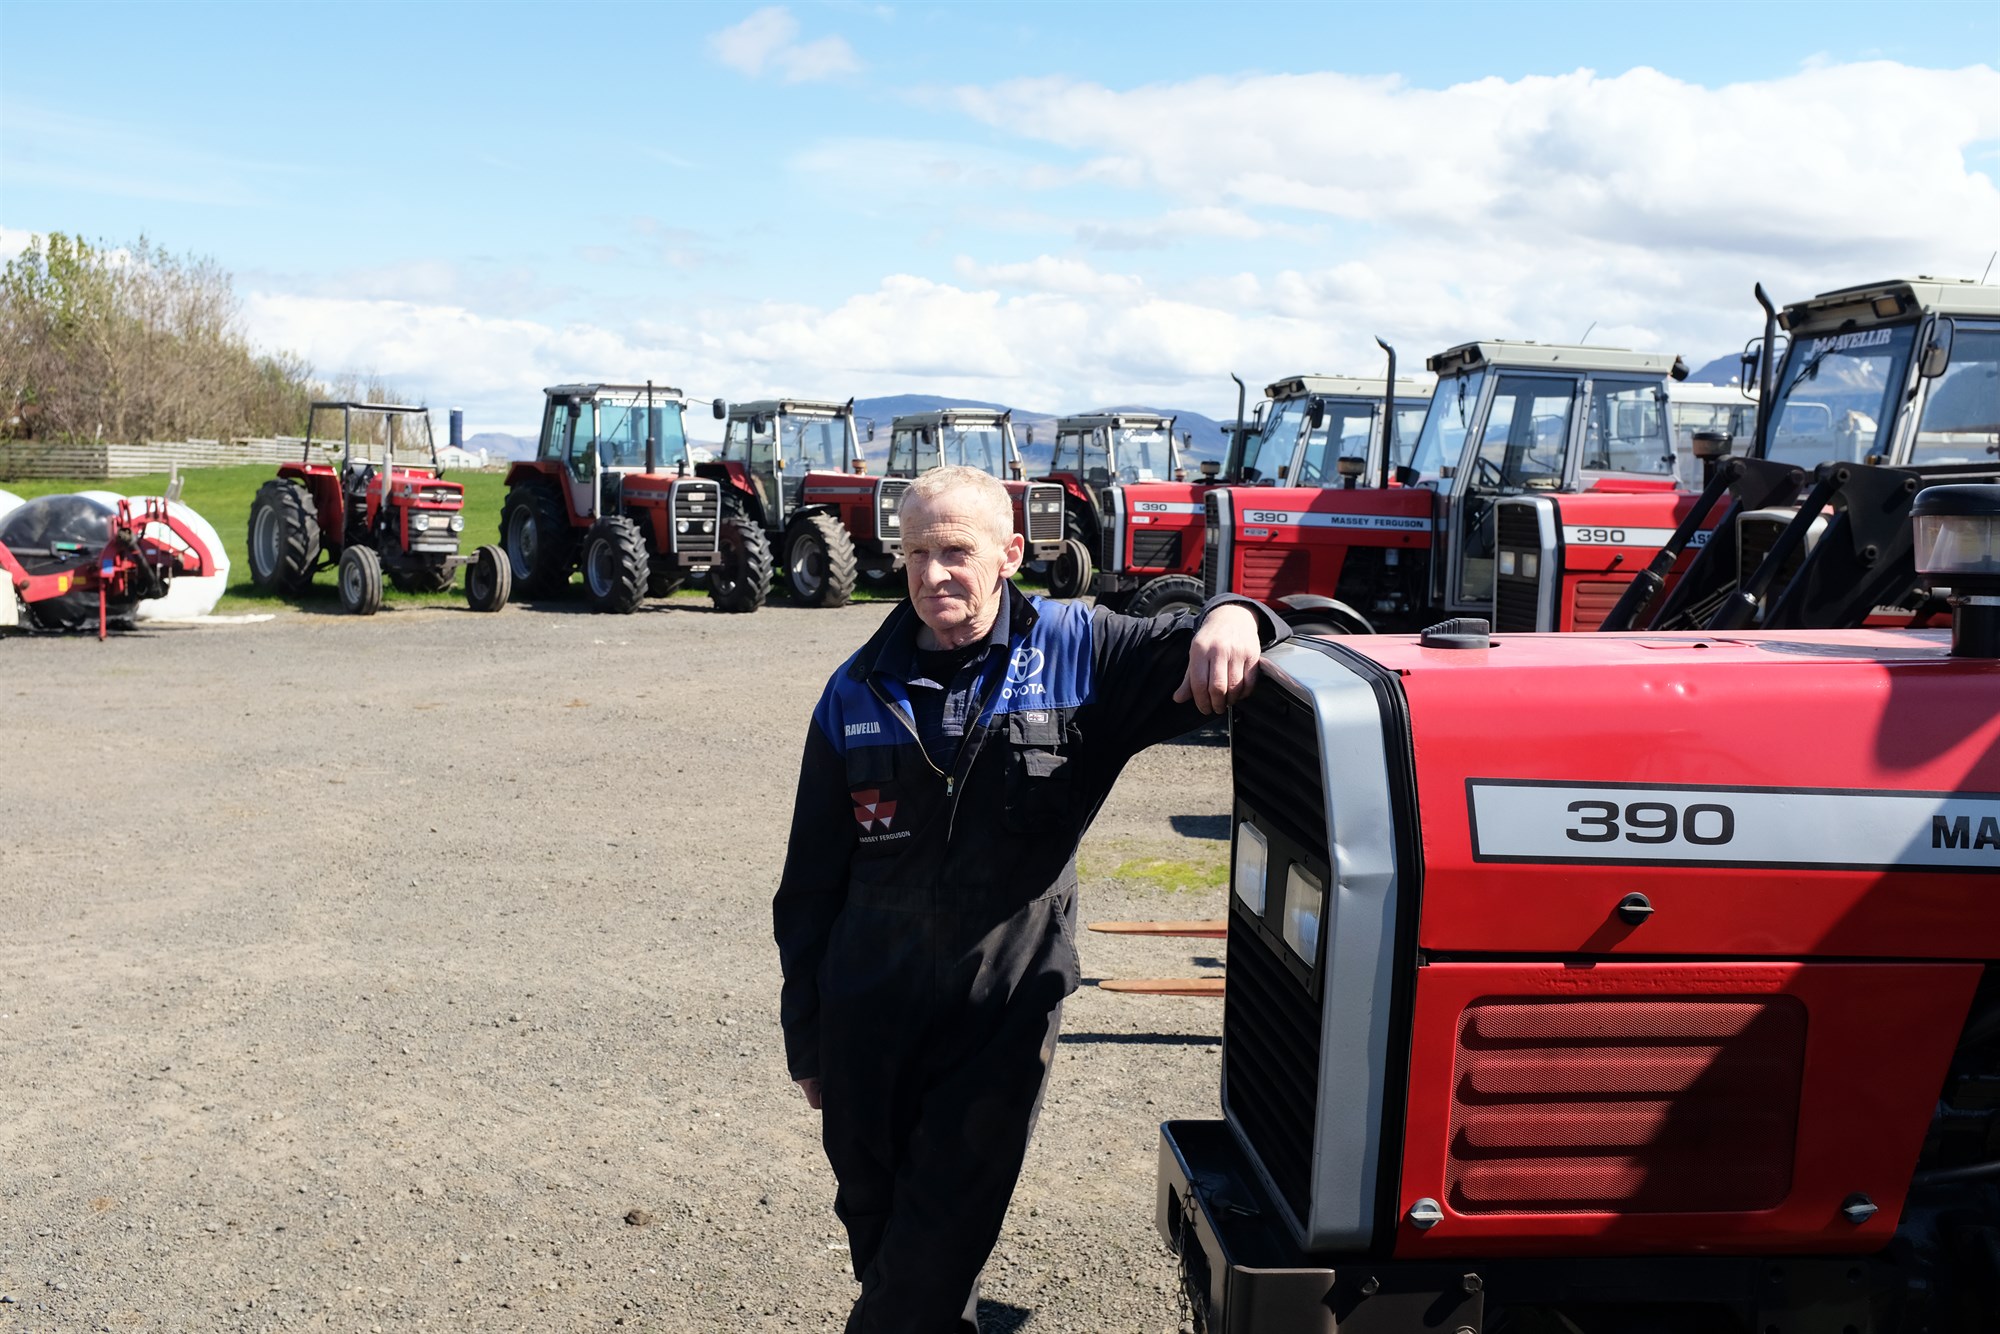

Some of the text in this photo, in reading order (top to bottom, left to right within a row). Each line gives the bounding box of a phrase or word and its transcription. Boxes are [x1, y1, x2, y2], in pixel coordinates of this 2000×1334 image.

[1142, 503, 1168, 512] 390
[1253, 512, 1424, 528] 390 MASSEY FERGUSON
[1577, 528, 1626, 543] 390
[1002, 683, 1047, 700] OYOTA
[1565, 800, 1735, 846] 390
[879, 830, 911, 841] FERGUSON
